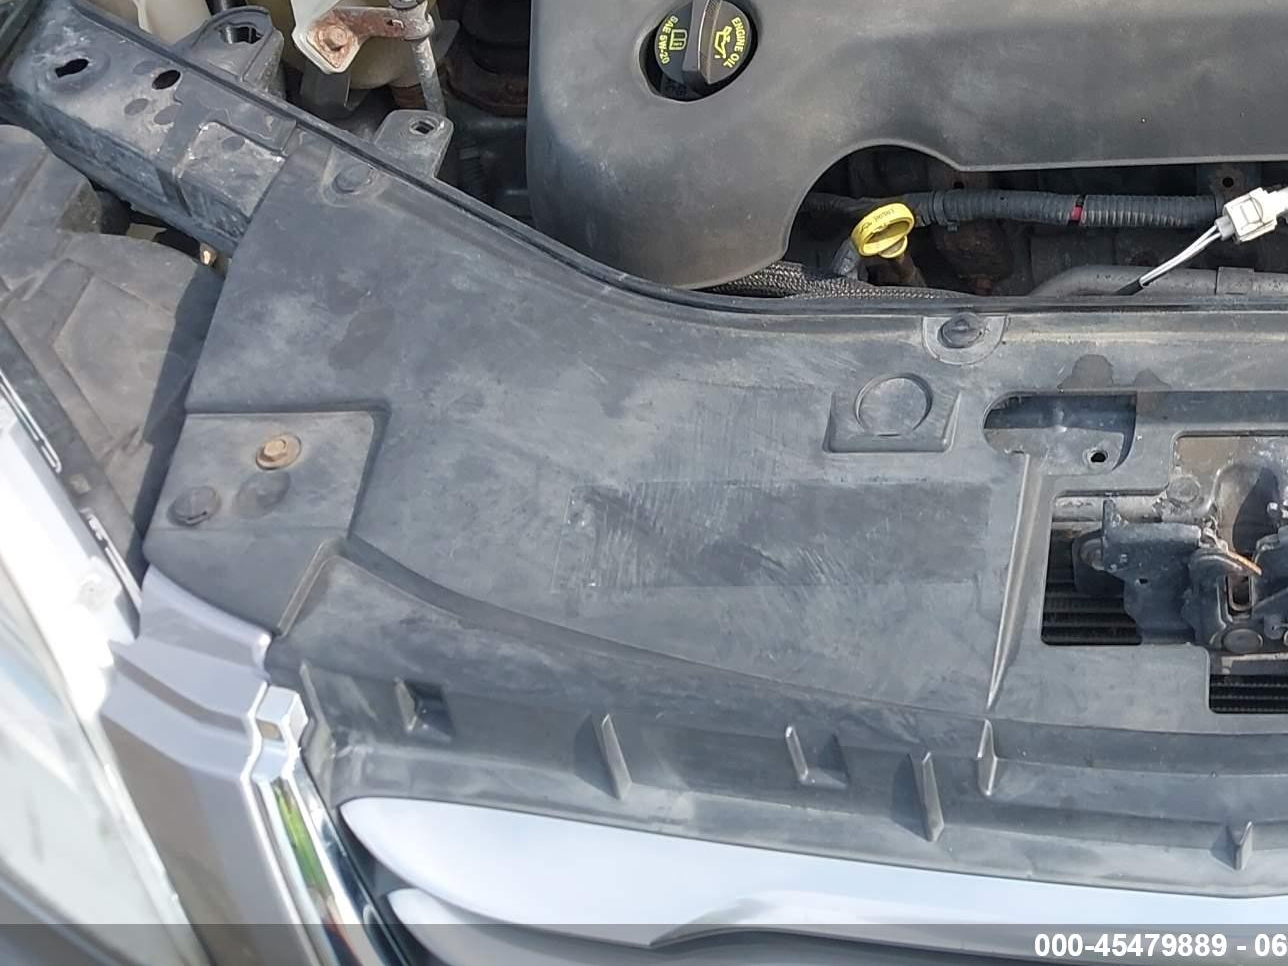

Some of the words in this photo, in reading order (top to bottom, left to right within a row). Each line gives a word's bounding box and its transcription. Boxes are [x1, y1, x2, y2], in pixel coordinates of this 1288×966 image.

[662, 15, 679, 34] SAE
[731, 17, 746, 53] ENGINE
[658, 34, 671, 65] 5W-20
[723, 53, 740, 68] OIL
